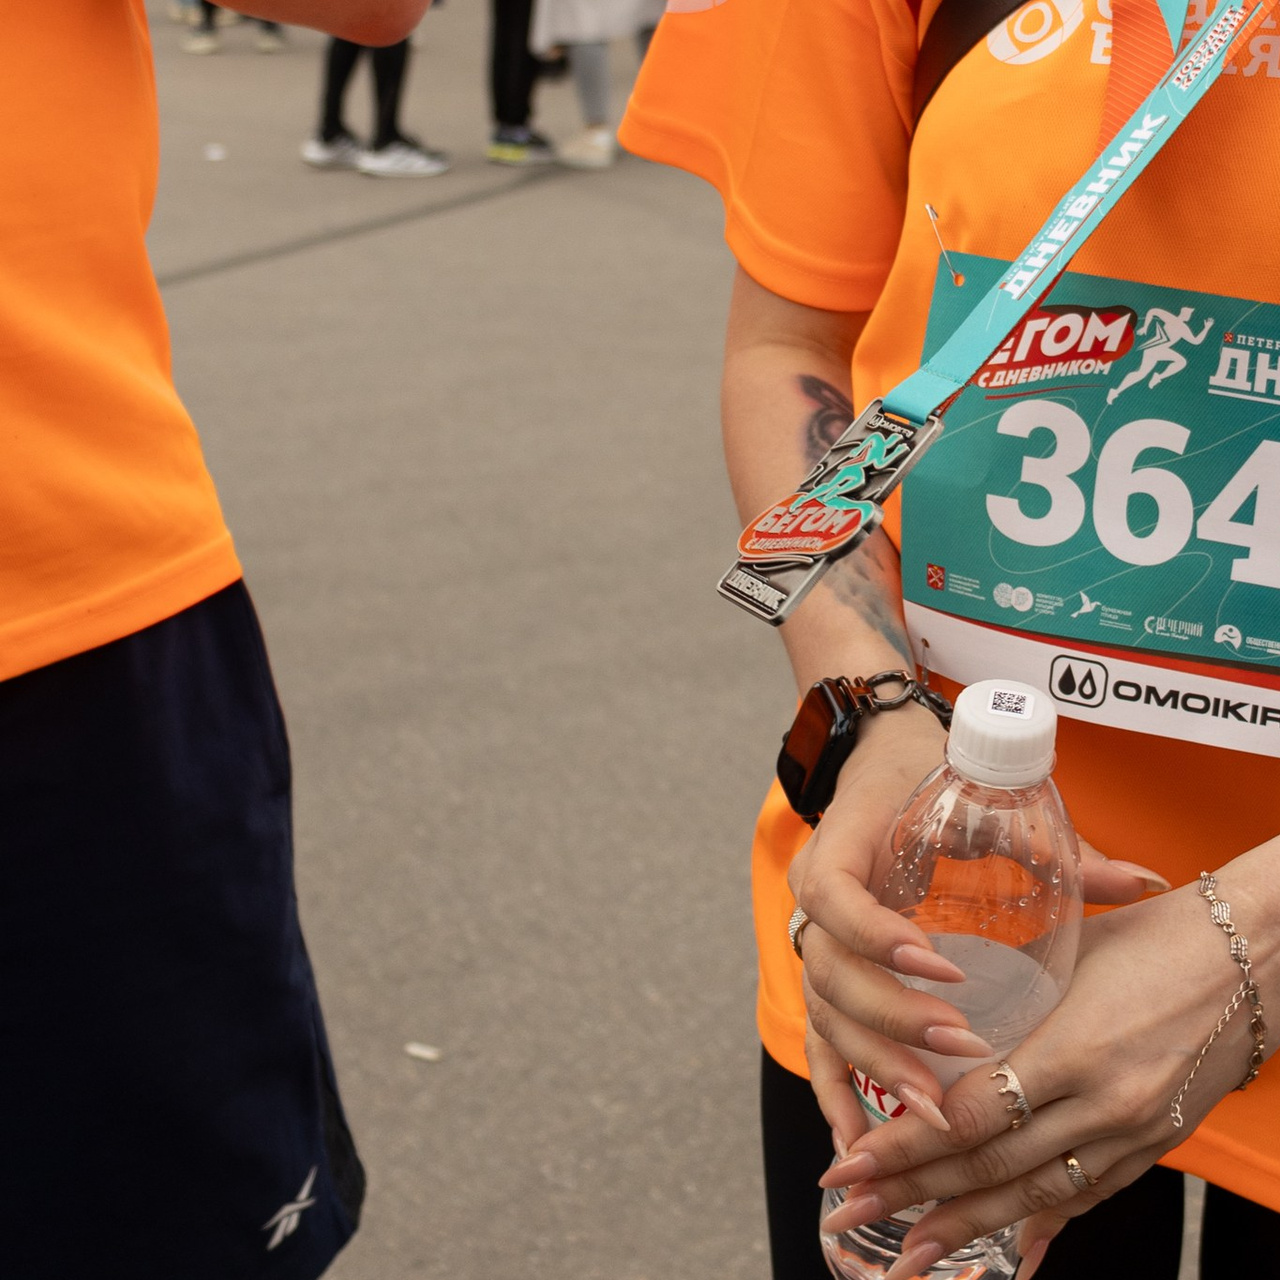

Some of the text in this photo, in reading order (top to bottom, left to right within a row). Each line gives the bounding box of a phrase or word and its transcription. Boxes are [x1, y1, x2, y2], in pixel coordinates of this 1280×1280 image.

[1002, 112, 1168, 300] ДНЕВНИК
[977, 358, 1114, 388] С ДНЕВНИКОМ
[753, 506, 861, 535] БЕГОМ
